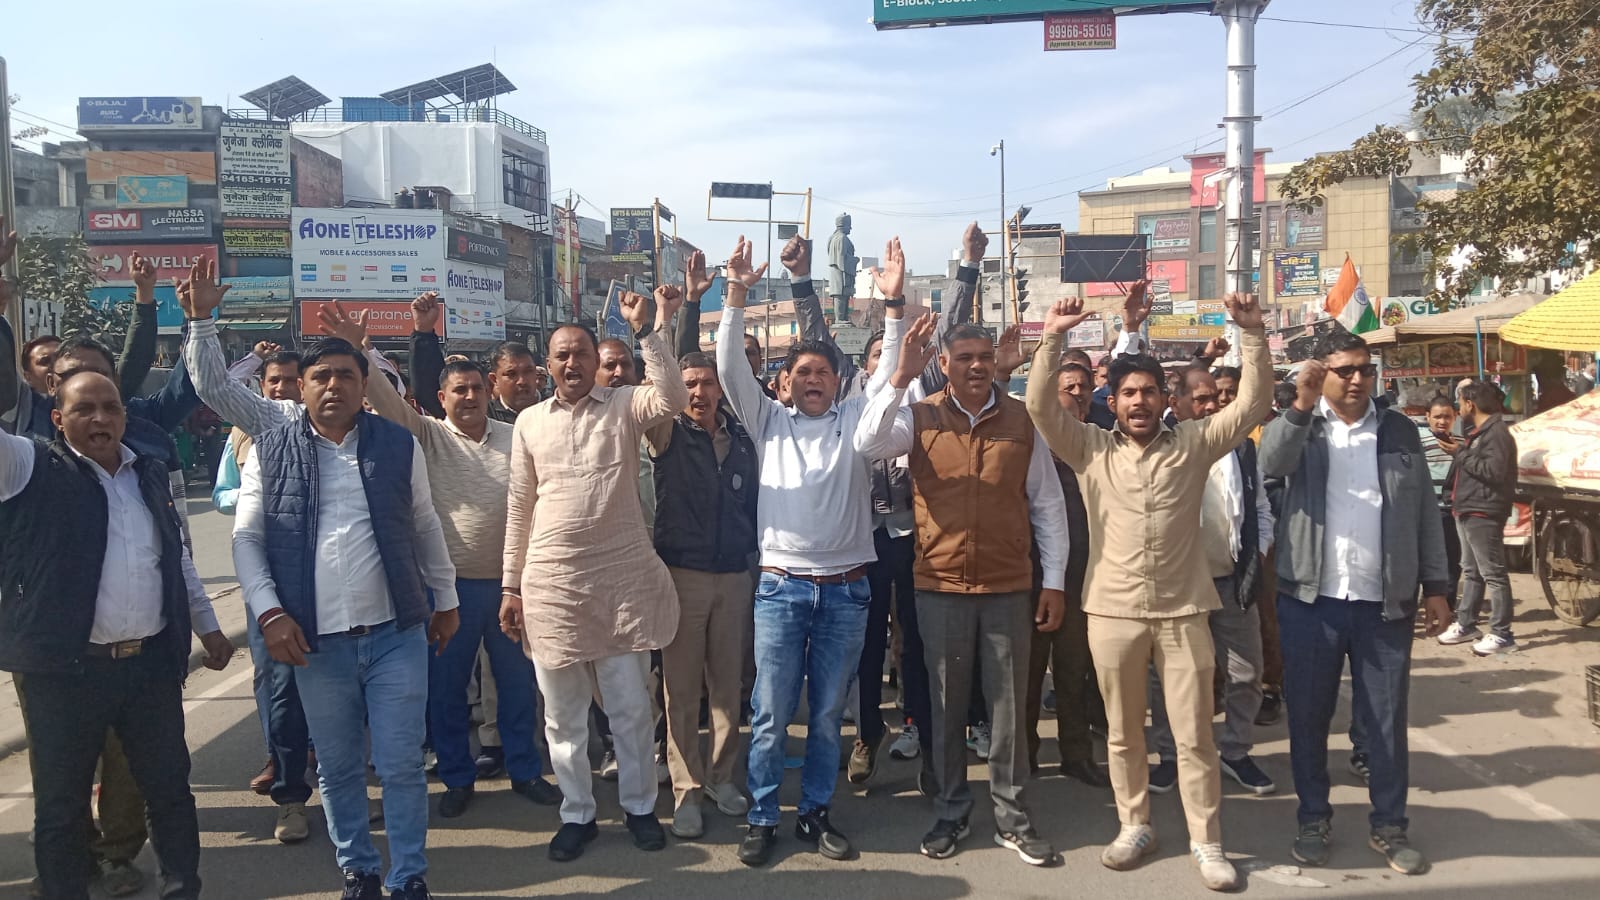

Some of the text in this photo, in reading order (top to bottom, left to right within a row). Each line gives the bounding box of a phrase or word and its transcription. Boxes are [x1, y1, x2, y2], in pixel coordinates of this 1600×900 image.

[1049, 24, 1112, 39] 99966-55105
[222, 132, 283, 152] जुनेजा क्लीनिक
[299, 218, 437, 240] AONE TELESHOP
[468, 241, 500, 256] PORTRONICS
[469, 277, 503, 293] TELESHOP
